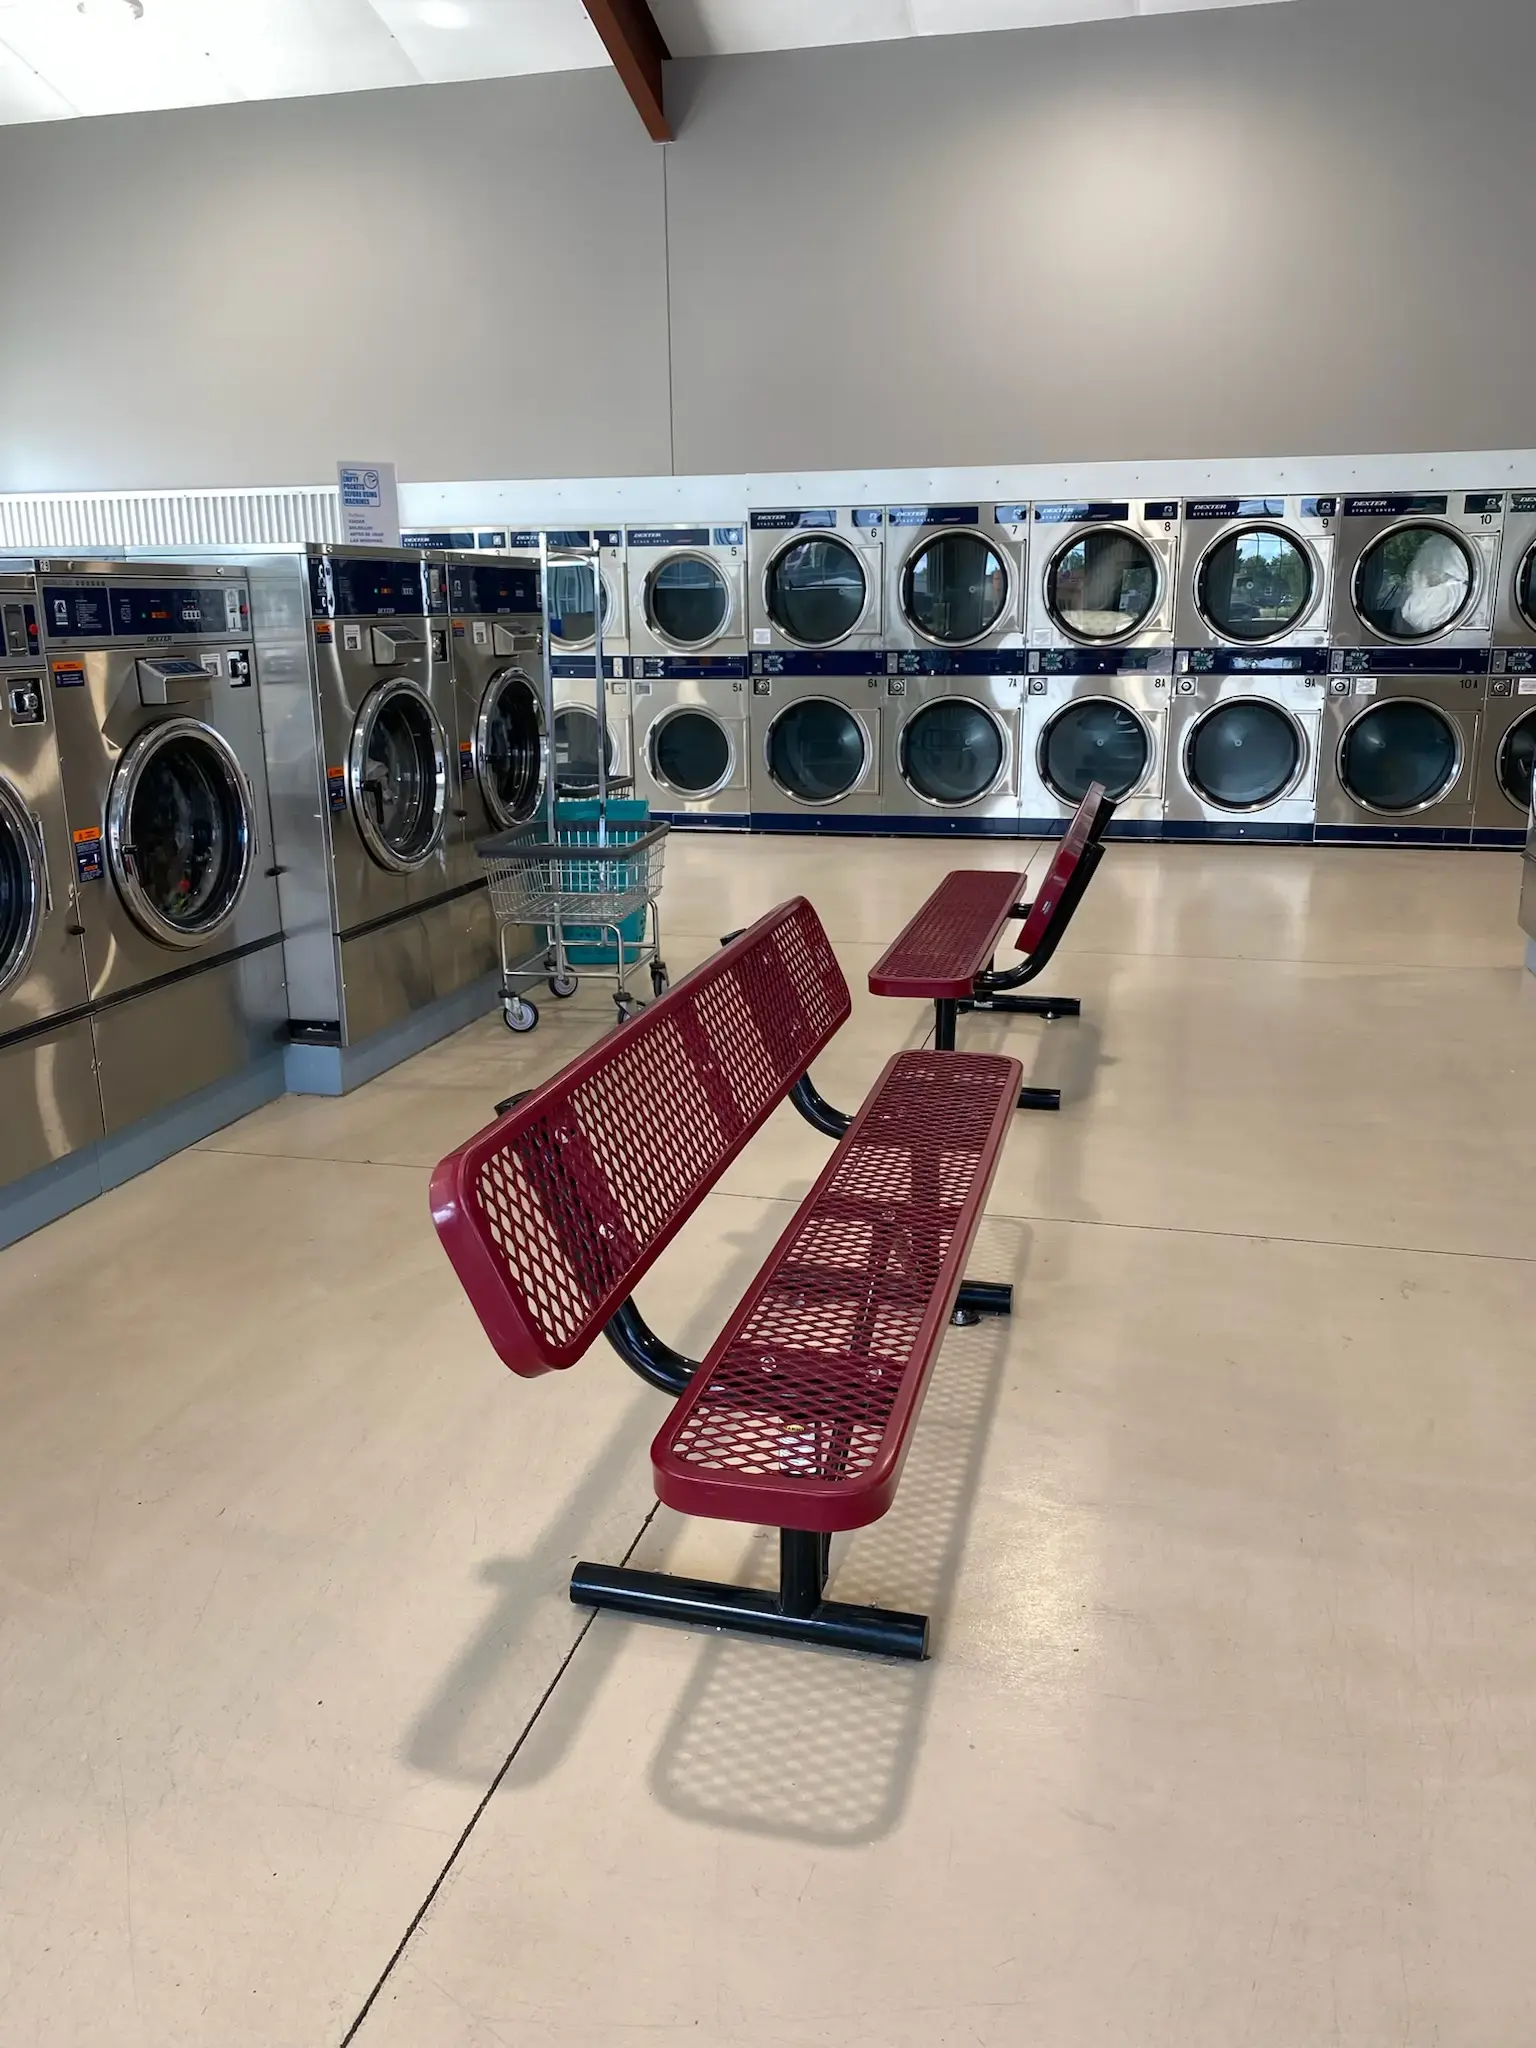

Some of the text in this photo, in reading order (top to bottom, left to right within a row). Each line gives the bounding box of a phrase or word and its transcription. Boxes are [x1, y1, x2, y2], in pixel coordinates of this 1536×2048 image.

[1322, 518, 1329, 528] 9
[1480, 514, 1492, 525] 10
[1012, 525, 1018, 535] 7
[1164, 521, 1171, 531] 8
[870, 528, 877, 538] 6
[610, 549, 617, 558] 4
[731, 547, 737, 556] 5
[732, 683, 743, 692] 5A
[868, 679, 878, 688] 6A
[1008, 678, 1017, 688] 7A
[1154, 678, 1165, 688] 8A
[1304, 678, 1316, 688] 9A
